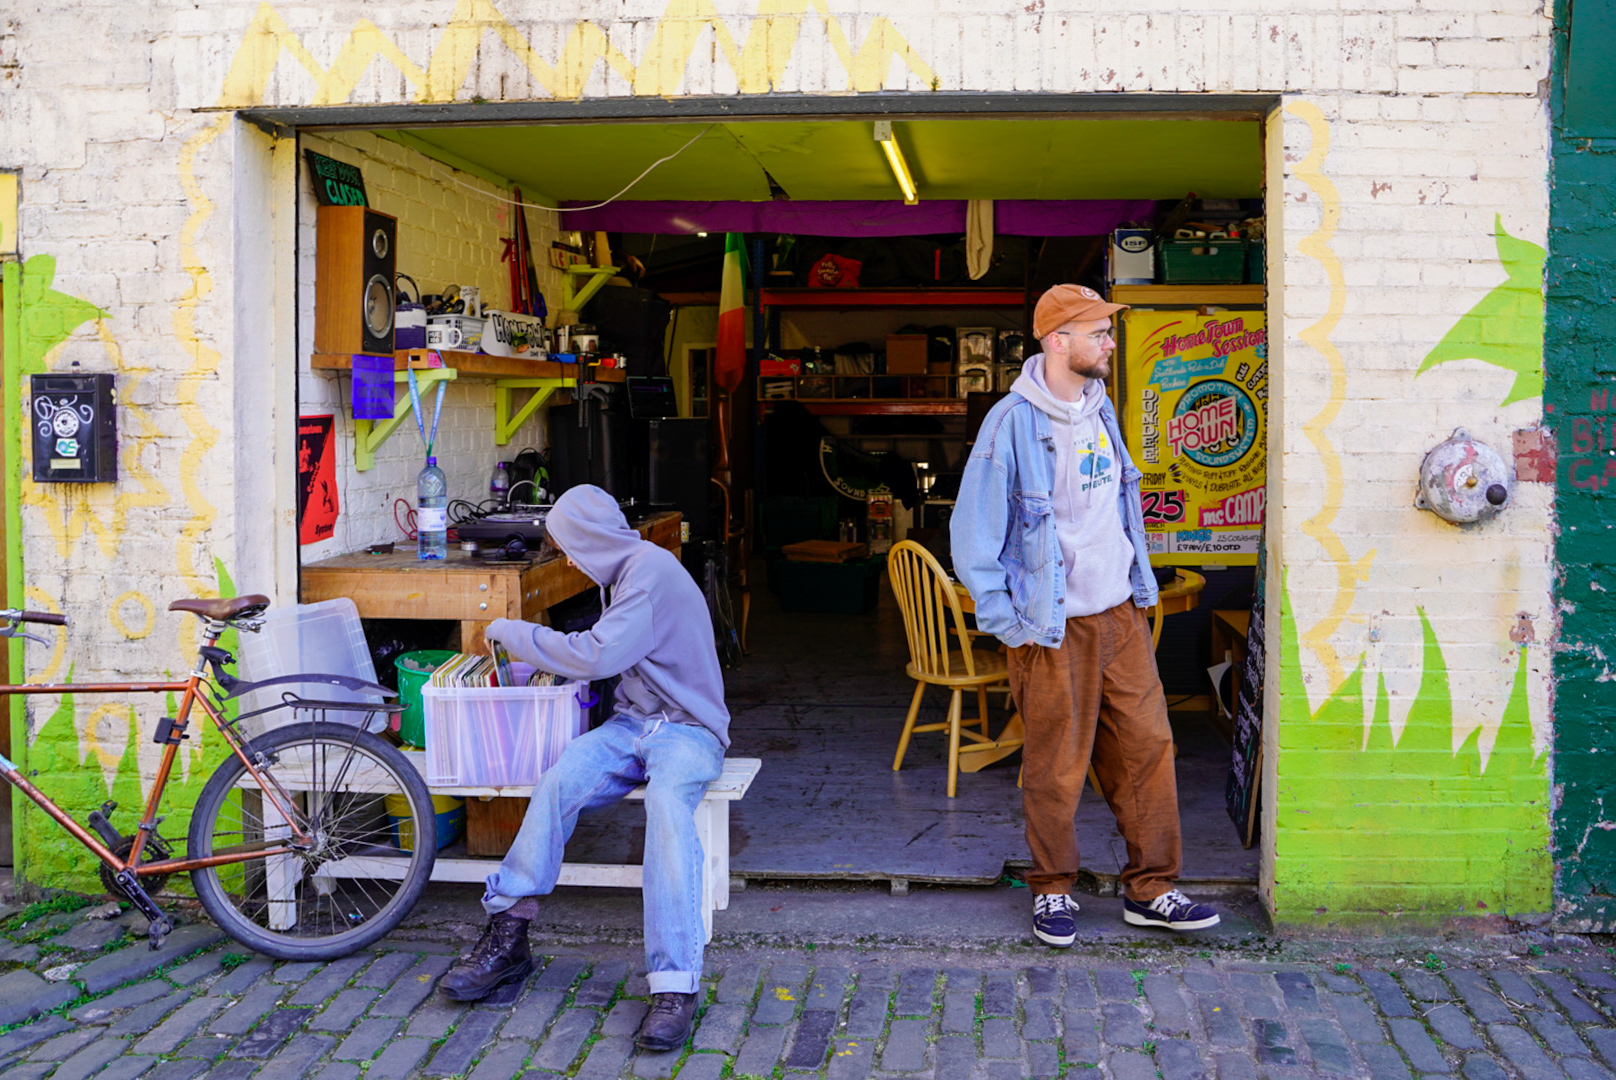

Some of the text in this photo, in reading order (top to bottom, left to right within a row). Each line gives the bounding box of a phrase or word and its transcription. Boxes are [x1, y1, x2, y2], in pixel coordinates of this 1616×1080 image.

[1141, 389, 1159, 464] DUNDEE
[1168, 397, 1234, 439] HOME
[1168, 416, 1234, 457] TOWN
[833, 477, 866, 497] SOUND
[1143, 472, 1166, 485] FRIDAY
[1142, 490, 1184, 523] 25
